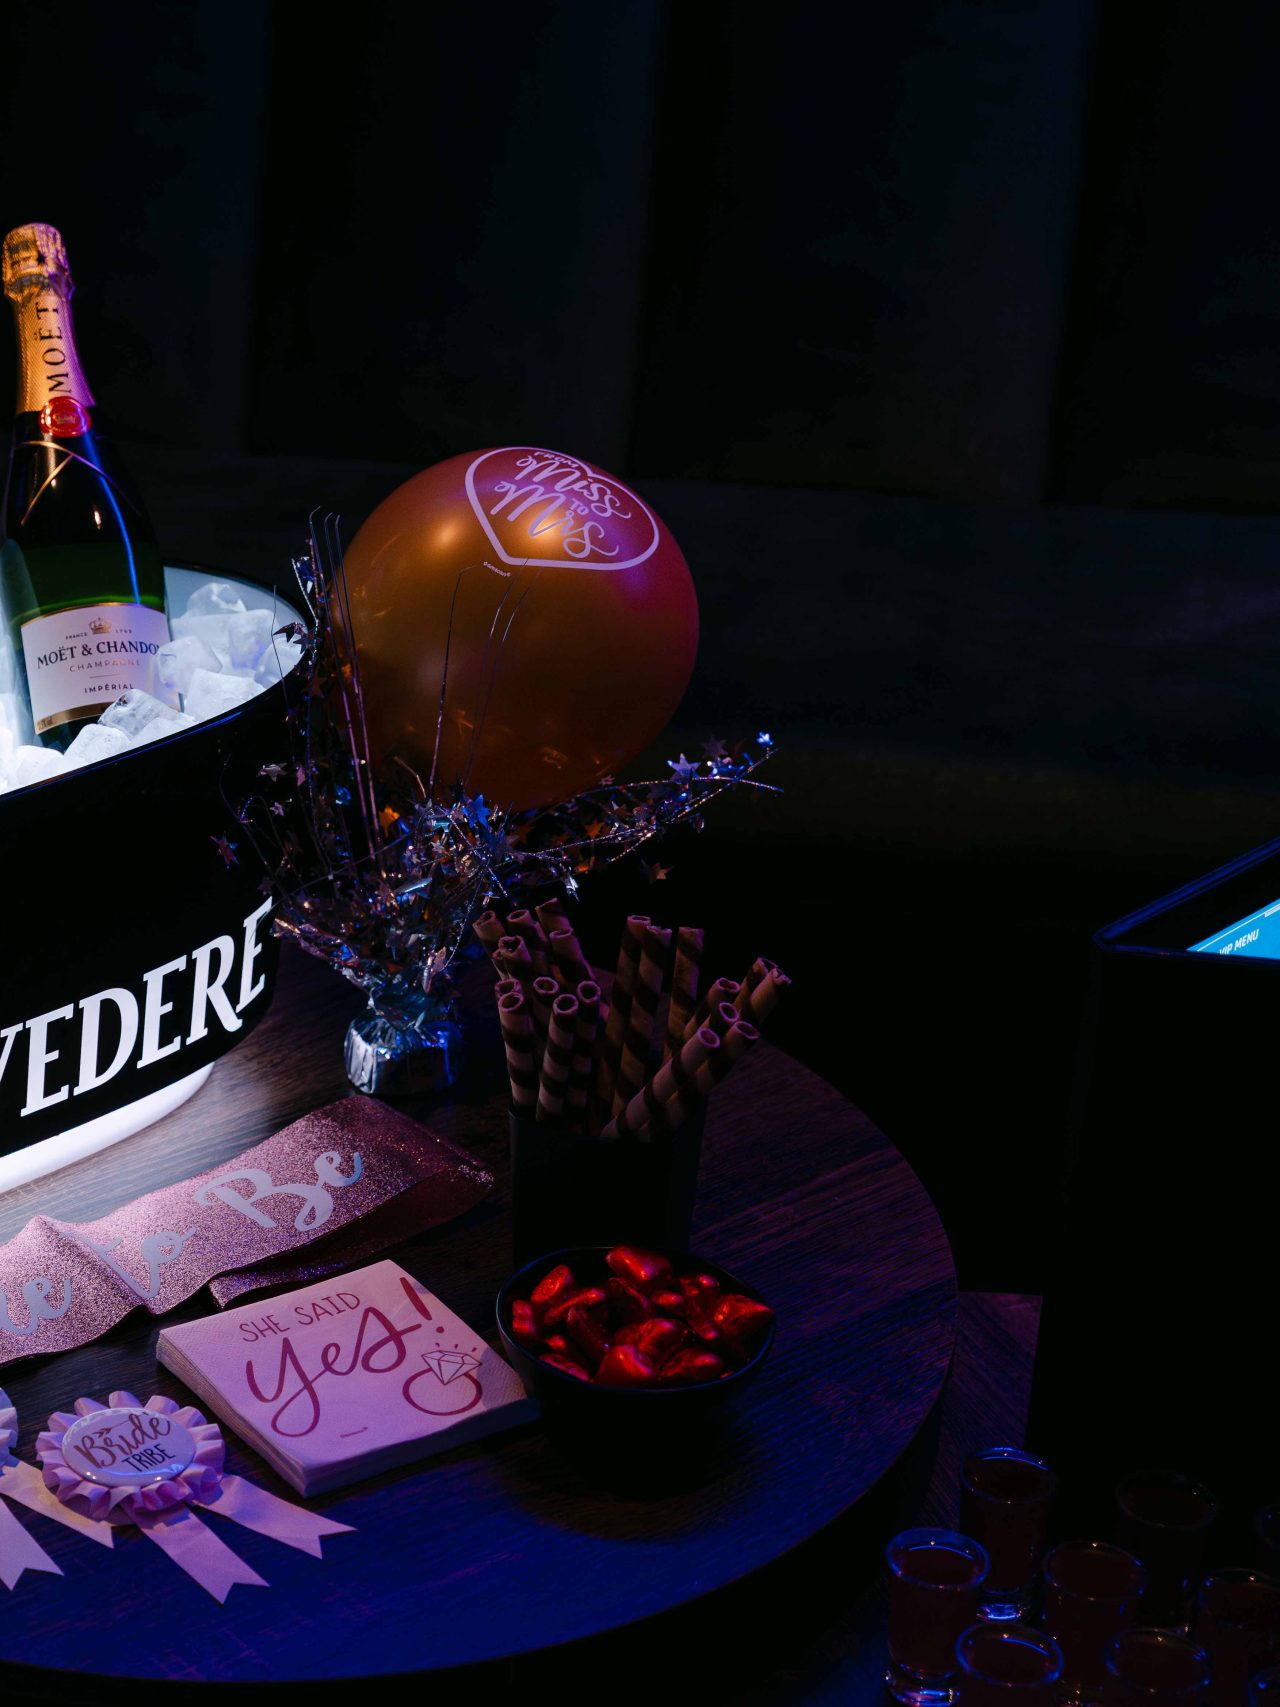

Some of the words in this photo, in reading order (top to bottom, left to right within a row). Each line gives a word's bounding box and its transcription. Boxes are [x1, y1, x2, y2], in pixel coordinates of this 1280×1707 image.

[533, 450, 580, 469] FROM
[570, 498, 589, 516] TO
[36, 645, 78, 670] MOËT
[81, 642, 93, 658] &
[69, 658, 141, 673] CHAMPAGNE
[84, 683, 135, 694] IMPÉRIAL
[1233, 928, 1260, 951] MENU
[193, 1150, 364, 1233] Be
[238, 1313, 290, 1343] SHE
[295, 1291, 361, 1326] SAID
[73, 1411, 171, 1469] Bride
[121, 1443, 177, 1473] TRIBE
